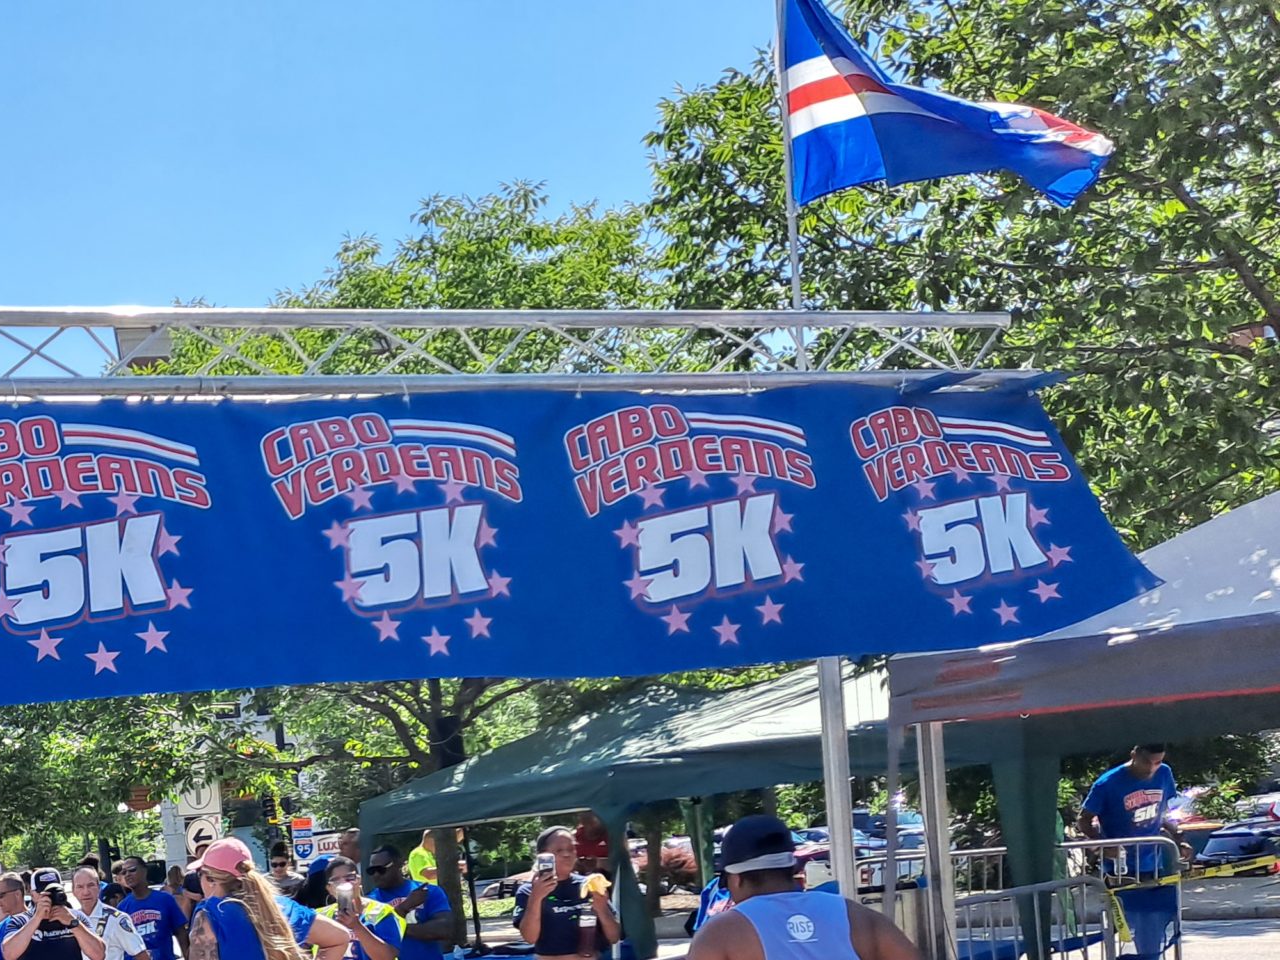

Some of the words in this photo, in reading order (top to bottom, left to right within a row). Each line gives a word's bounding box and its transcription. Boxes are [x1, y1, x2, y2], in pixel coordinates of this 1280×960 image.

[260, 412, 393, 478] CABO
[564, 404, 689, 472] CABO
[849, 406, 943, 460] CABO
[271, 443, 523, 520] VERDEANS
[574, 436, 817, 518] VERDEANS
[862, 438, 1071, 503] VERDEANS
[4, 513, 167, 625] 5K
[347, 504, 489, 607] 5K
[638, 493, 783, 603] 5K
[917, 492, 1048, 585] 5K
[297, 845, 310, 854] 95
[788, 920, 813, 933] RISE
